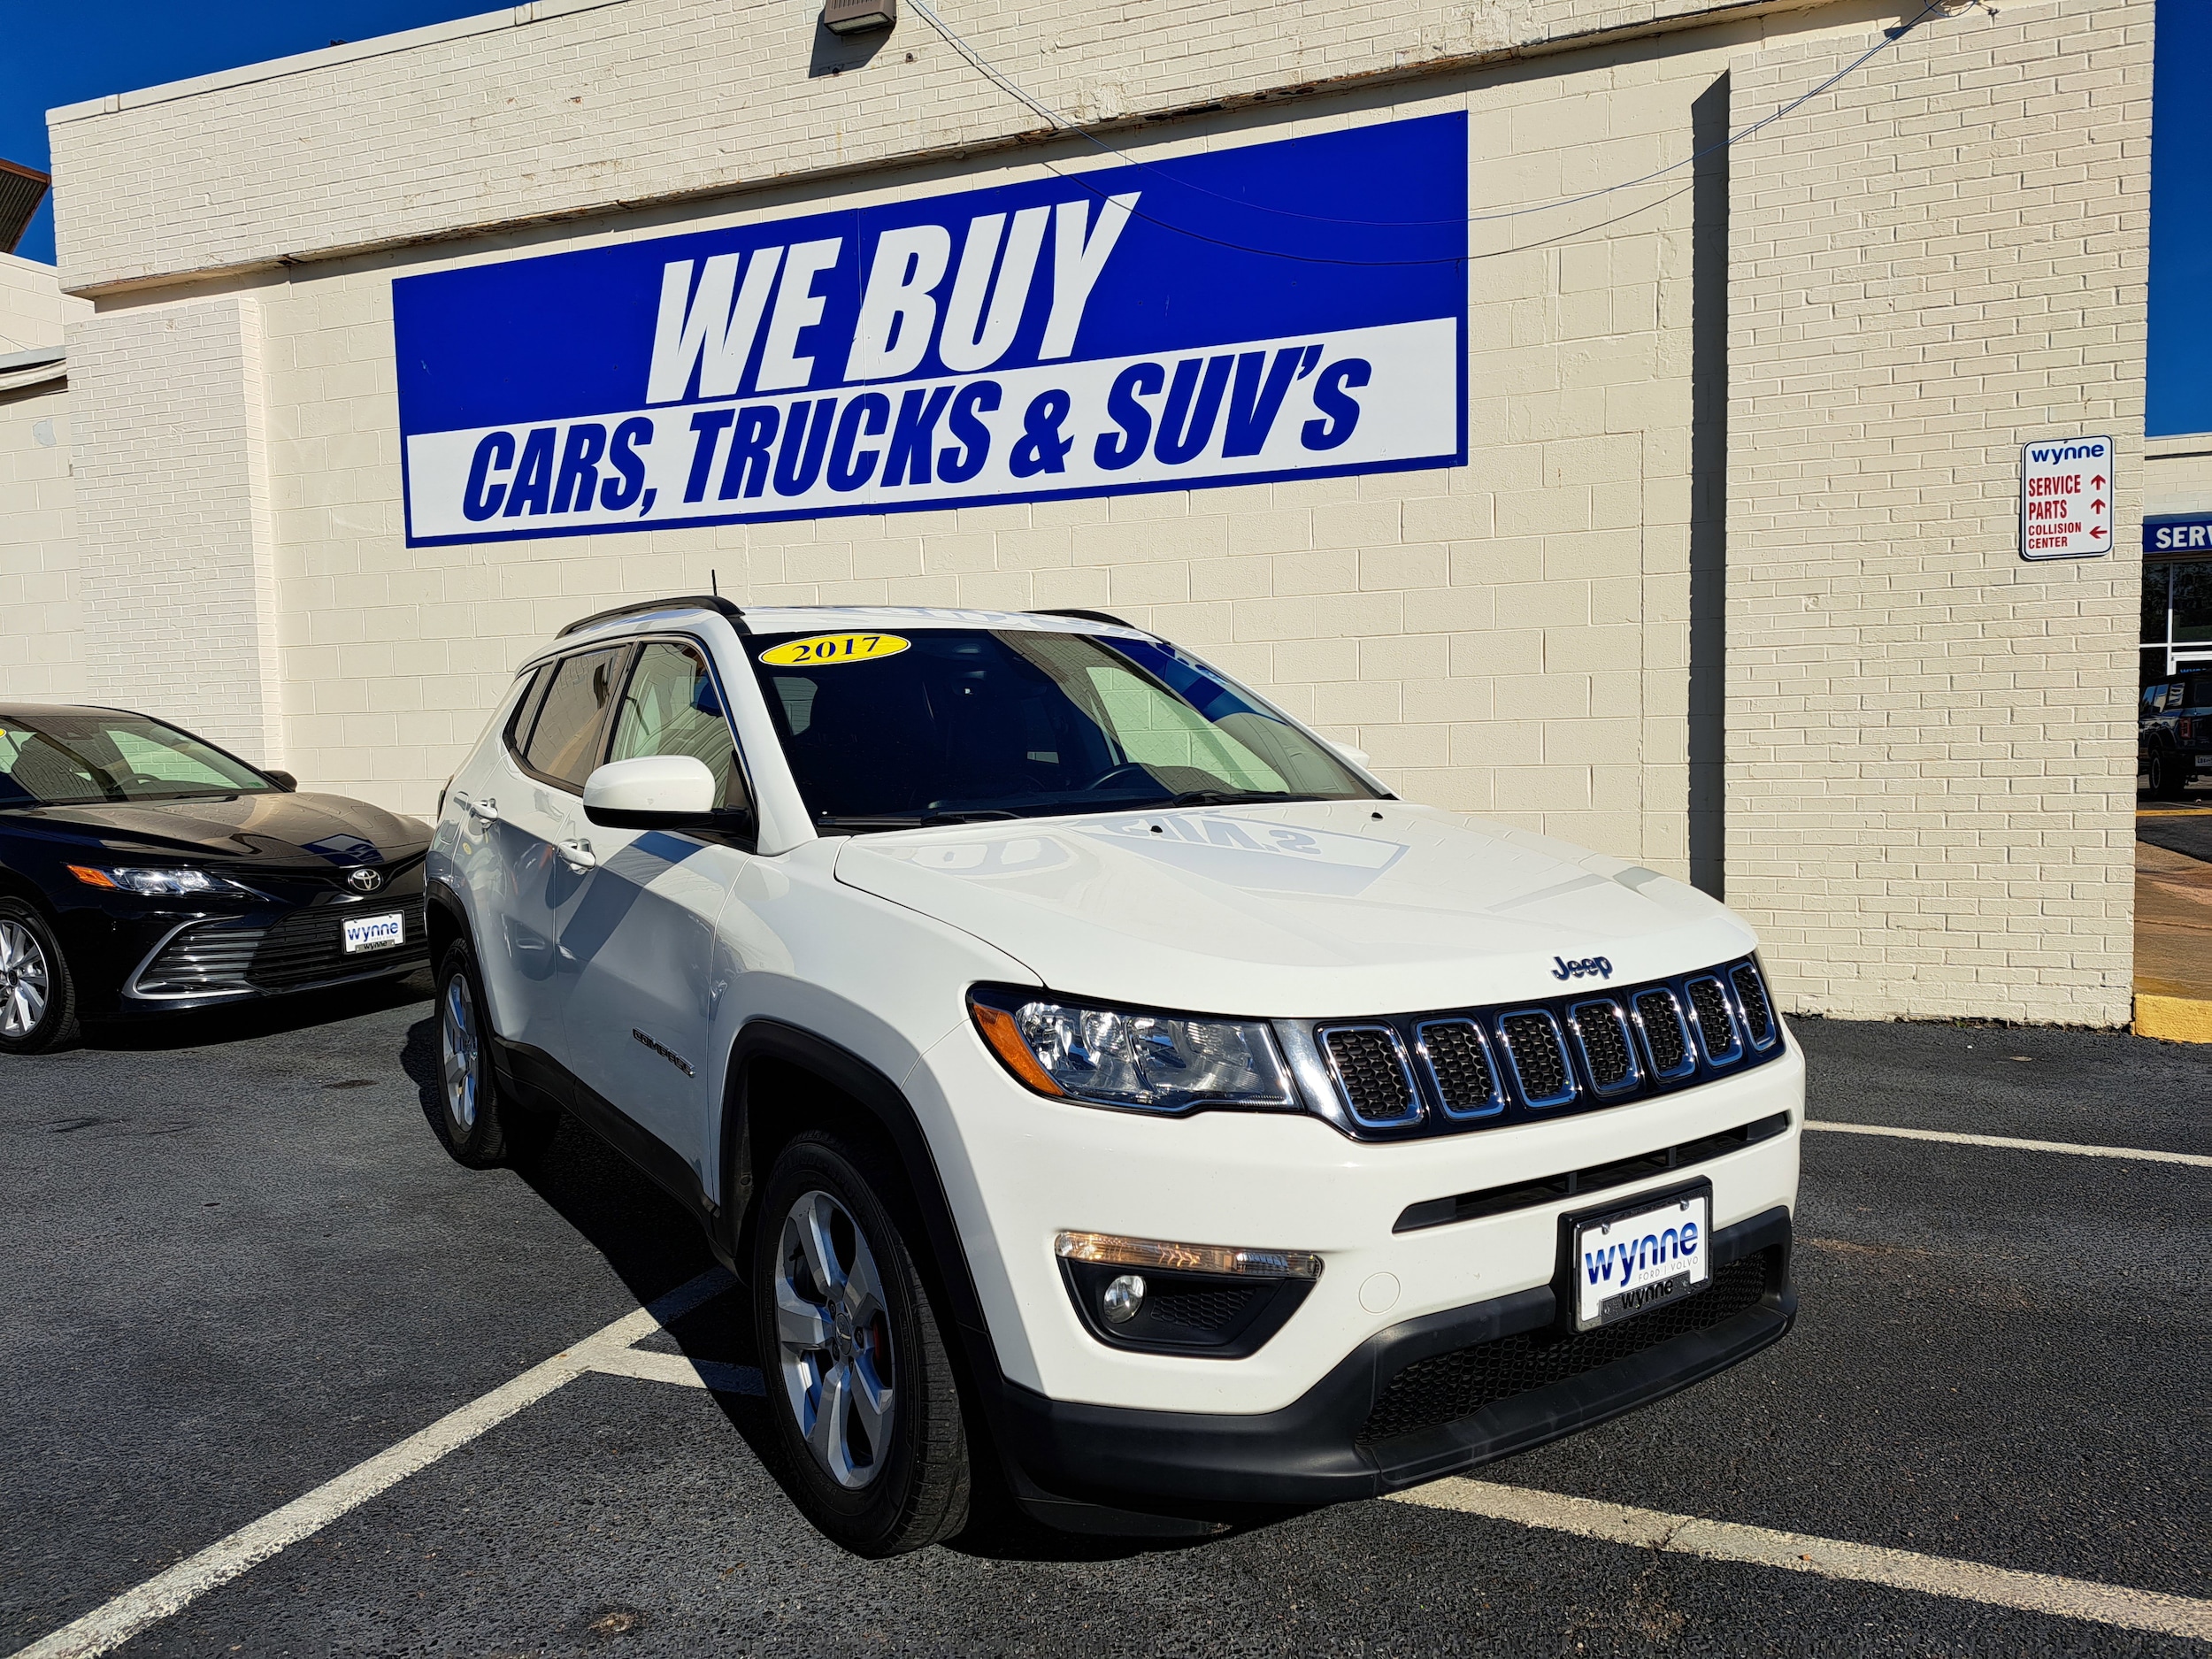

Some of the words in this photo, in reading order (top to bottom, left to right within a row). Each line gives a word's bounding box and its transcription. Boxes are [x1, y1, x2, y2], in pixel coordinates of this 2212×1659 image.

[645, 236, 843, 404] WE
[843, 191, 1142, 382] BUY
[463, 417, 657, 522] CARS,
[683, 380, 1002, 503] TRUCKS
[1009, 389, 1074, 479] &
[2032, 444, 2104, 465] wynne
[2029, 474, 2081, 497] SERVICE
[2029, 499, 2067, 520] PARTS
[2029, 522, 2081, 536] COLLISION
[2029, 536, 2068, 549] CENTER
[792, 636, 880, 663] 2017
[348, 922, 398, 942] wynne
[364, 941, 388, 949] wynne
[1551, 956, 1613, 980] Jeep
[1585, 1222, 1698, 1287] wynne
[1638, 1268, 1660, 1283] FORD
[1671, 1256, 1699, 1271] VOLVO
[1621, 1279, 1674, 1310] wynne
